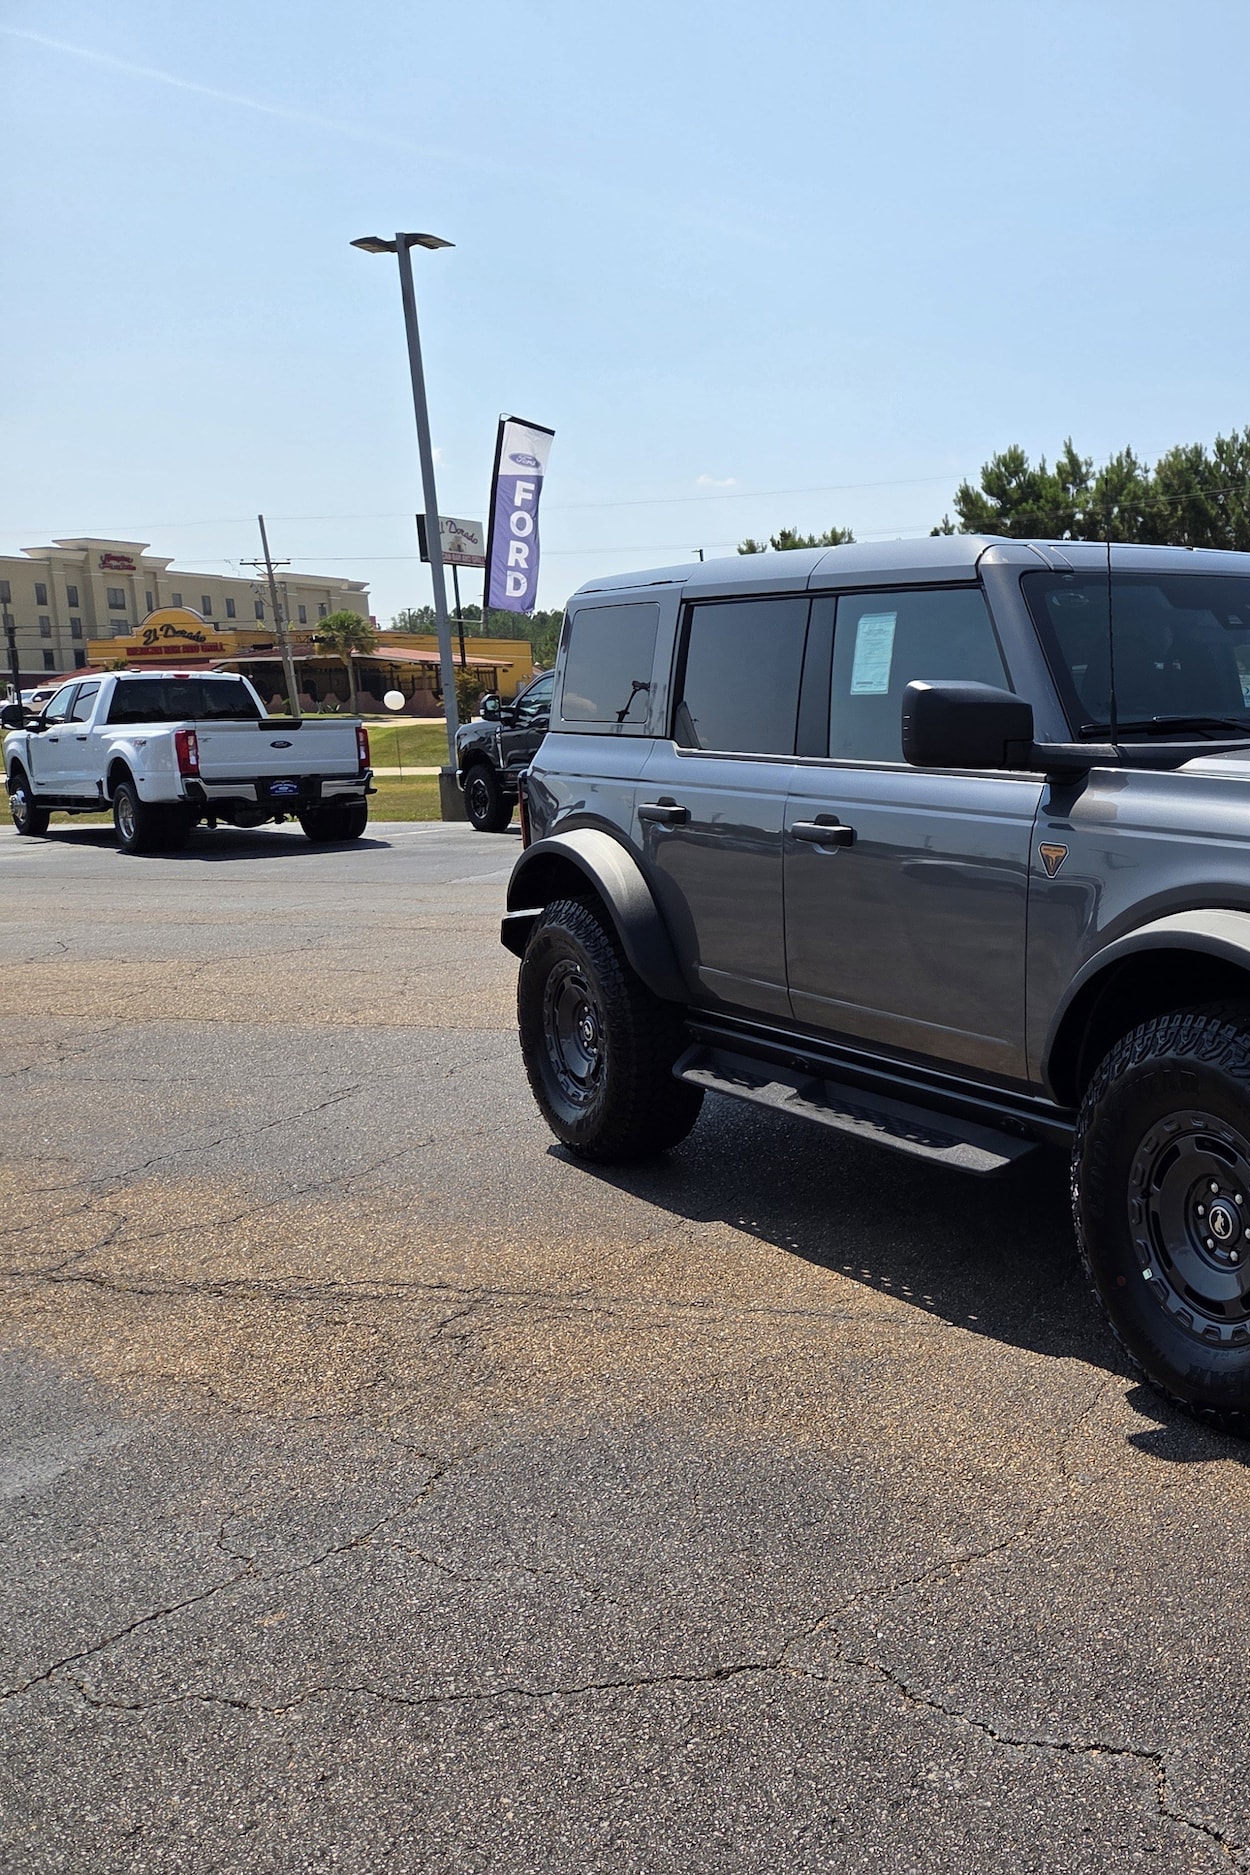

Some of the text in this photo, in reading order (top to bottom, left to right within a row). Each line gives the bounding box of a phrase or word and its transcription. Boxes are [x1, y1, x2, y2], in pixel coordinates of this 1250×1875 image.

[446, 520, 479, 545] Dorado
[506, 480, 535, 597] FORD
[143, 624, 206, 645] El Dorado
